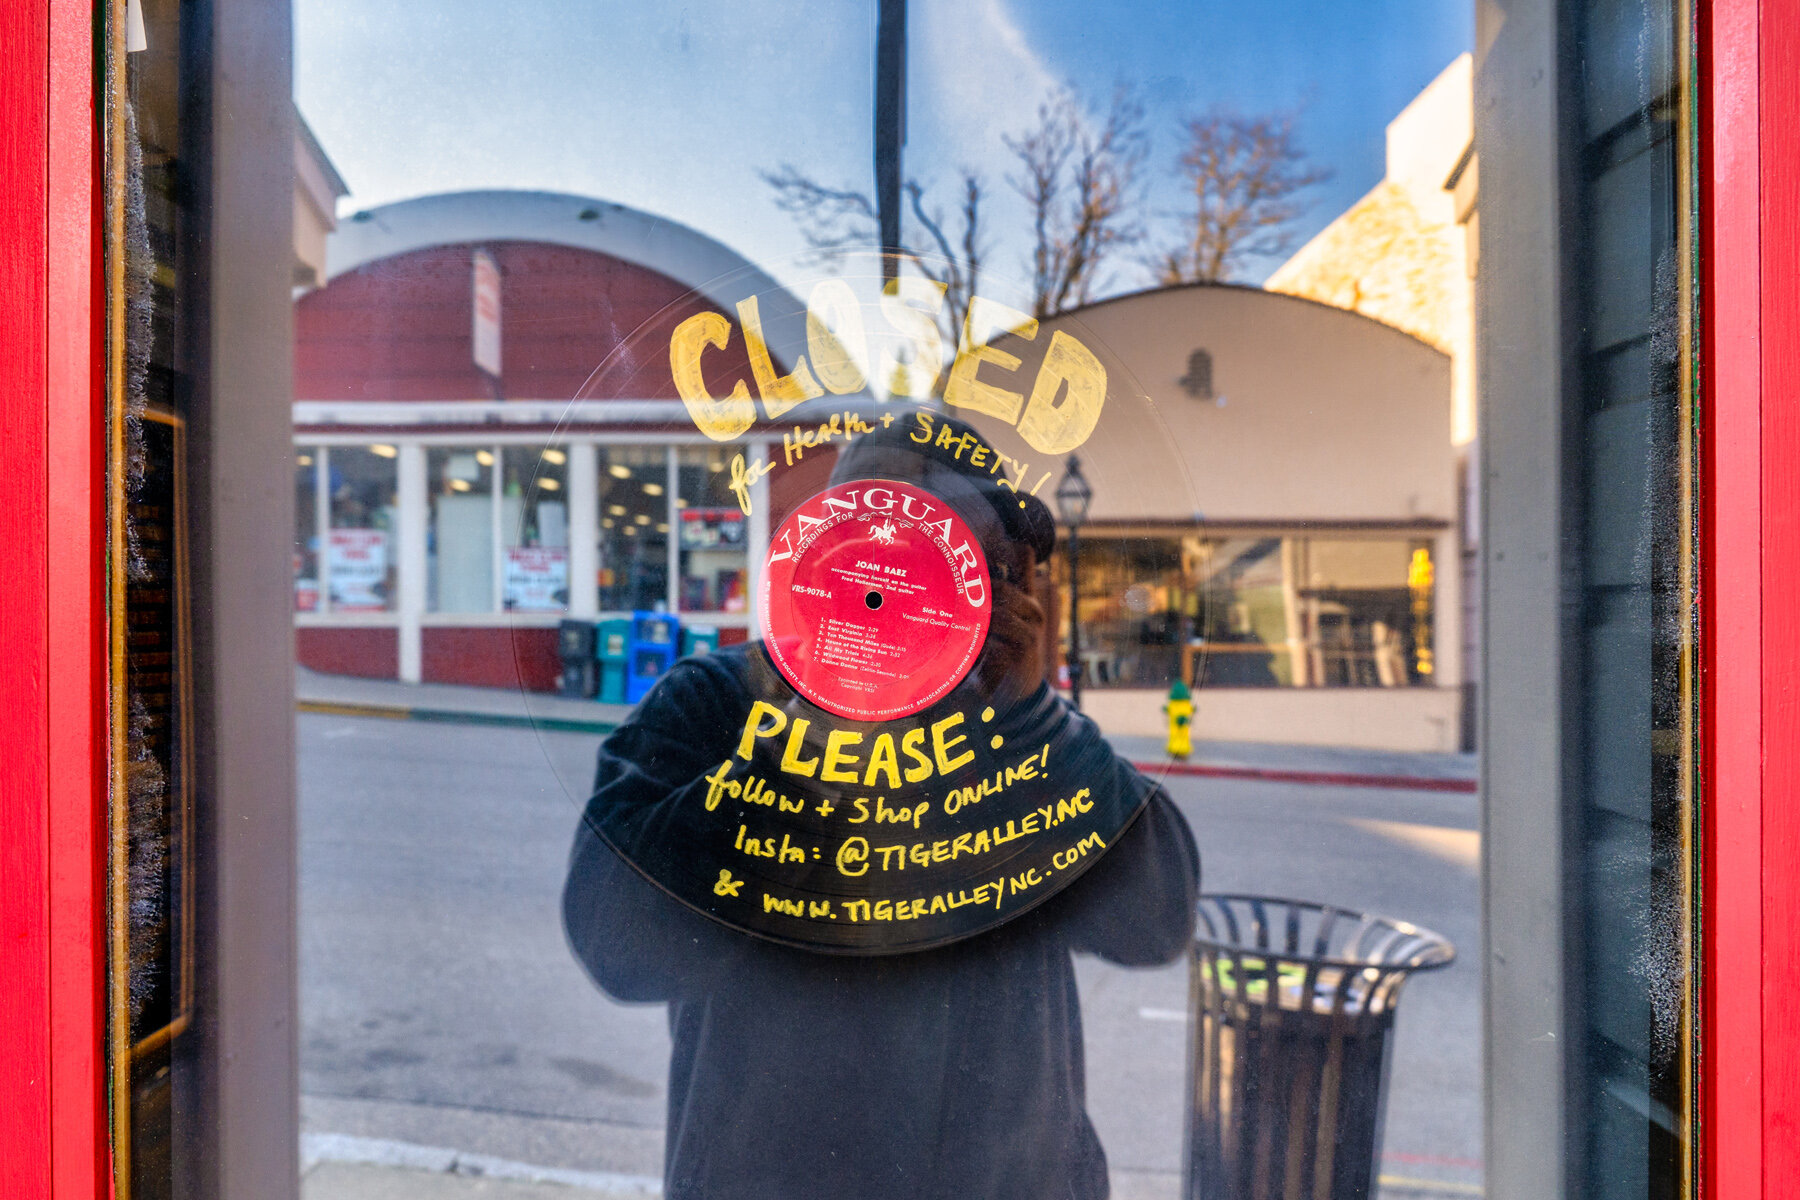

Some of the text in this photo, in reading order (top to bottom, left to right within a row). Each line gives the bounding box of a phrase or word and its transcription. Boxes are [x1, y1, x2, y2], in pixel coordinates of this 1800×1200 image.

[669, 276, 1108, 456] CLOSED
[728, 453, 775, 516] for
[783, 411, 874, 466] Health
[909, 411, 1053, 509] SAFETY!
[768, 489, 986, 608] VANGUARD
[792, 512, 965, 595] RECORDINGS FOR THE CONNOISSEUR
[831, 567, 869, 579] accompanying
[871, 574, 889, 583] herself
[910, 582, 927, 591] guitar
[855, 560, 908, 577] JOAN BAEZ
[792, 583, 832, 600] VRS-9078-A
[841, 575, 854, 583] Fred
[885, 583, 897, 591] 2nd
[898, 587, 915, 595] guitar
[828, 618, 844, 626] Silver
[902, 612, 971, 632] Vanguard Quality Control
[922, 606, 953, 618] Side One
[768, 632, 785, 663] RECORDING
[818, 695, 856, 714] UNAUTHORIZED
[877, 703, 915, 715] PERFORMANCE
[916, 681, 950, 706] BROADCASTING
[949, 674, 957, 682] OR
[955, 655, 971, 674] COPYING
[968, 623, 982, 654] PROHIBITED
[736, 700, 1004, 789] PLEASE:
[943, 743, 1051, 816] ONLINE!
[713, 868, 745, 897] &
